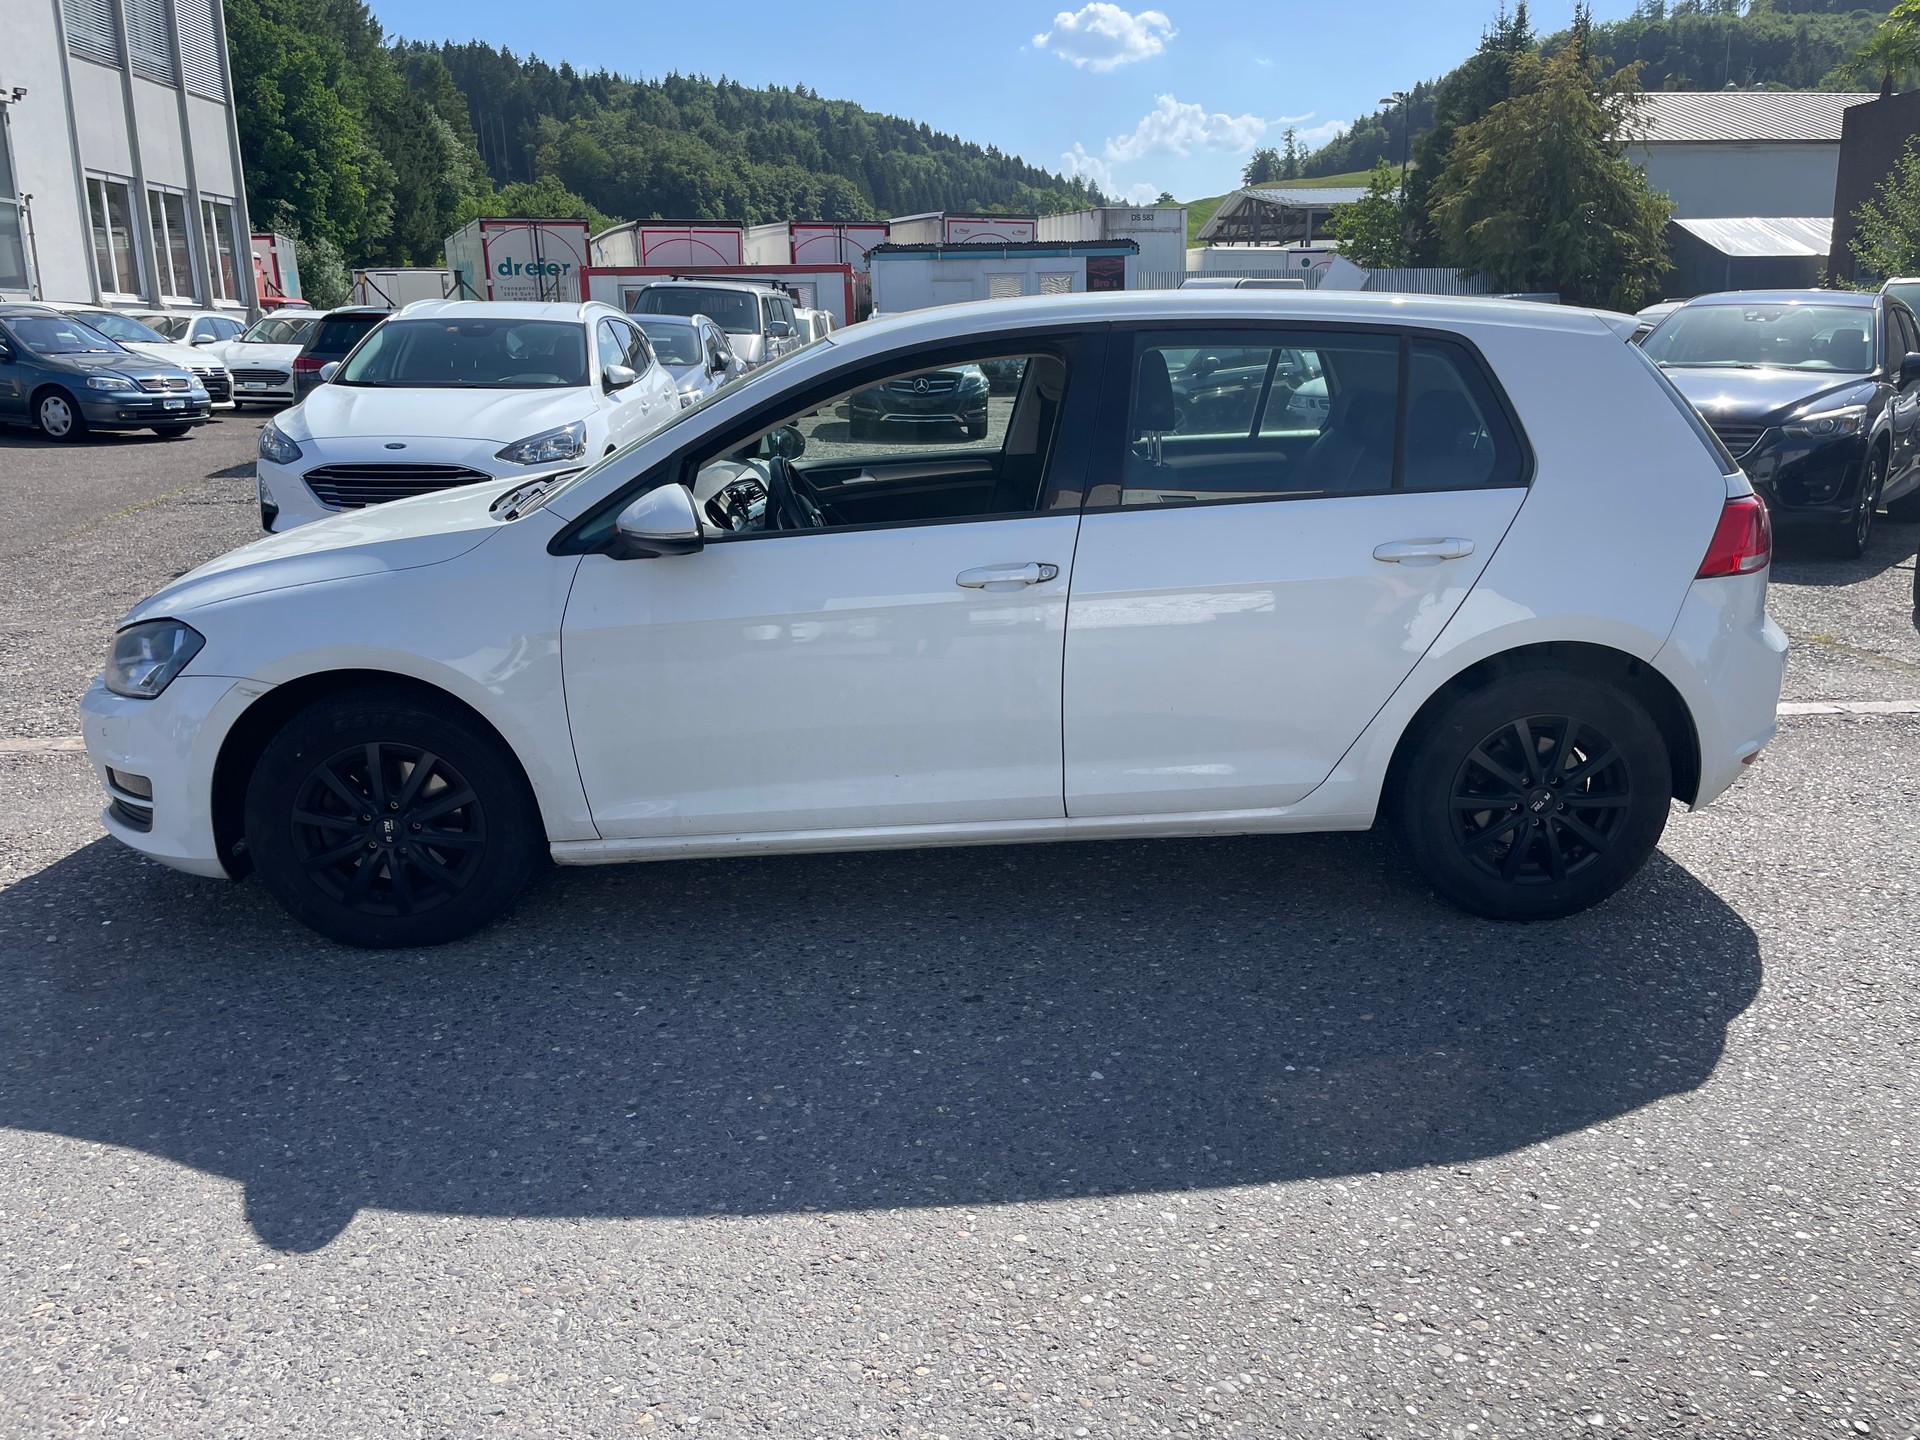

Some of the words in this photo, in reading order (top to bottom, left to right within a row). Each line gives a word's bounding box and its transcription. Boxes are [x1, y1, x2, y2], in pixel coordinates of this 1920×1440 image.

[1131, 213, 1141, 221] DS
[1142, 213, 1155, 221] 583
[498, 257, 570, 276] dreier
